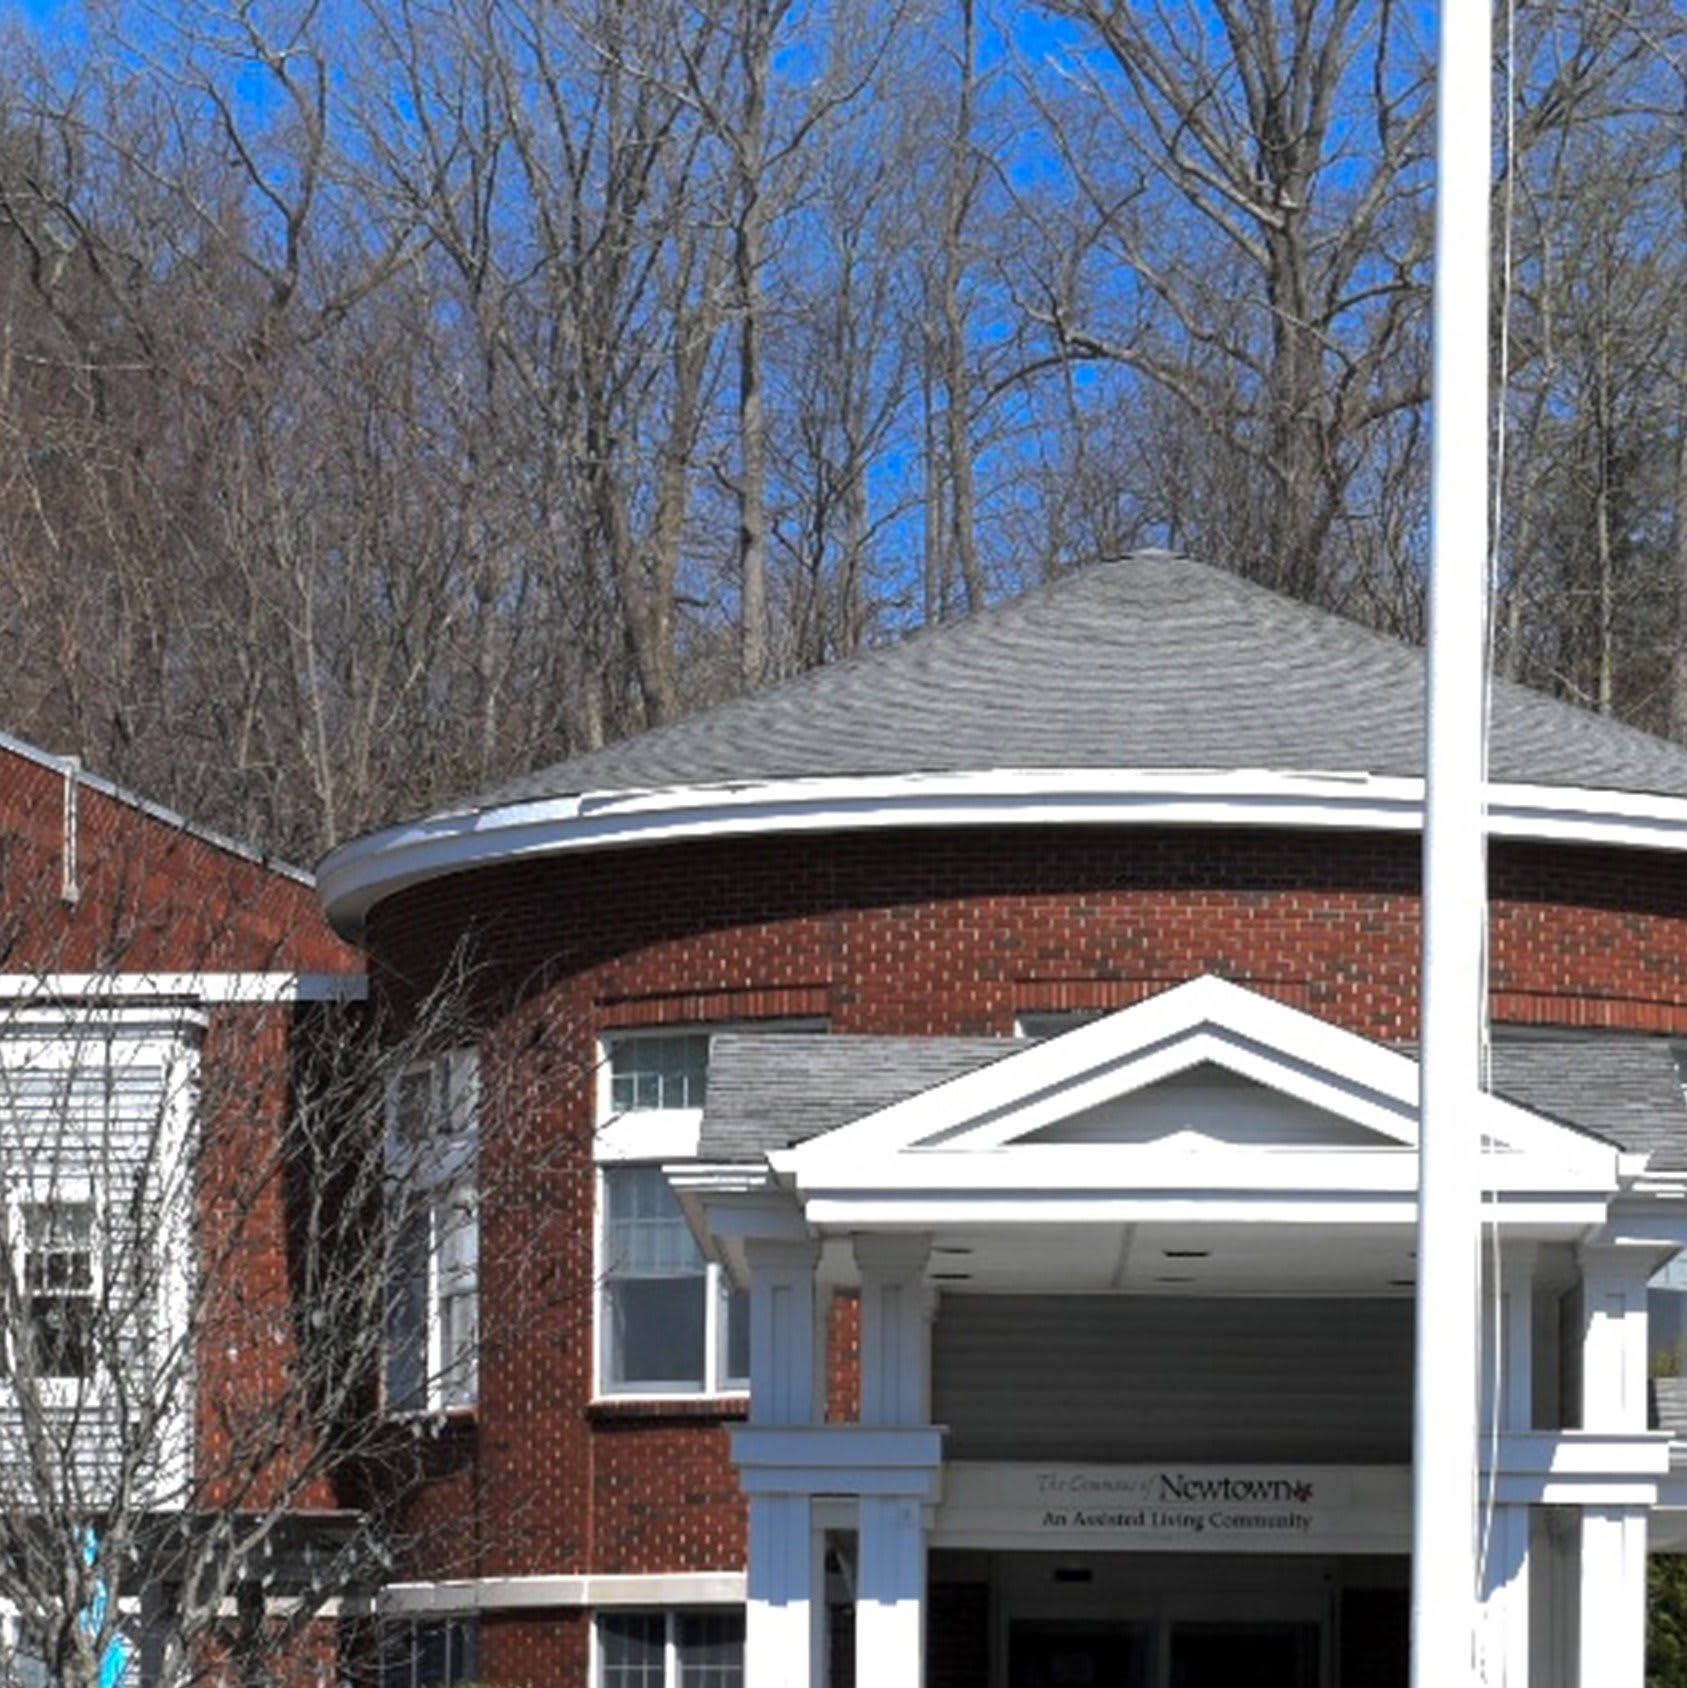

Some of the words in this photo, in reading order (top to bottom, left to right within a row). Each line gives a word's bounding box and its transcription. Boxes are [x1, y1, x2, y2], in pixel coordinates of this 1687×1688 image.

[1159, 1473, 1291, 1501] Newtown
[1042, 1511, 1067, 1527] An
[1072, 1509, 1145, 1527] Assisted
[1151, 1510, 1203, 1533] Living
[1208, 1511, 1312, 1533] Community
